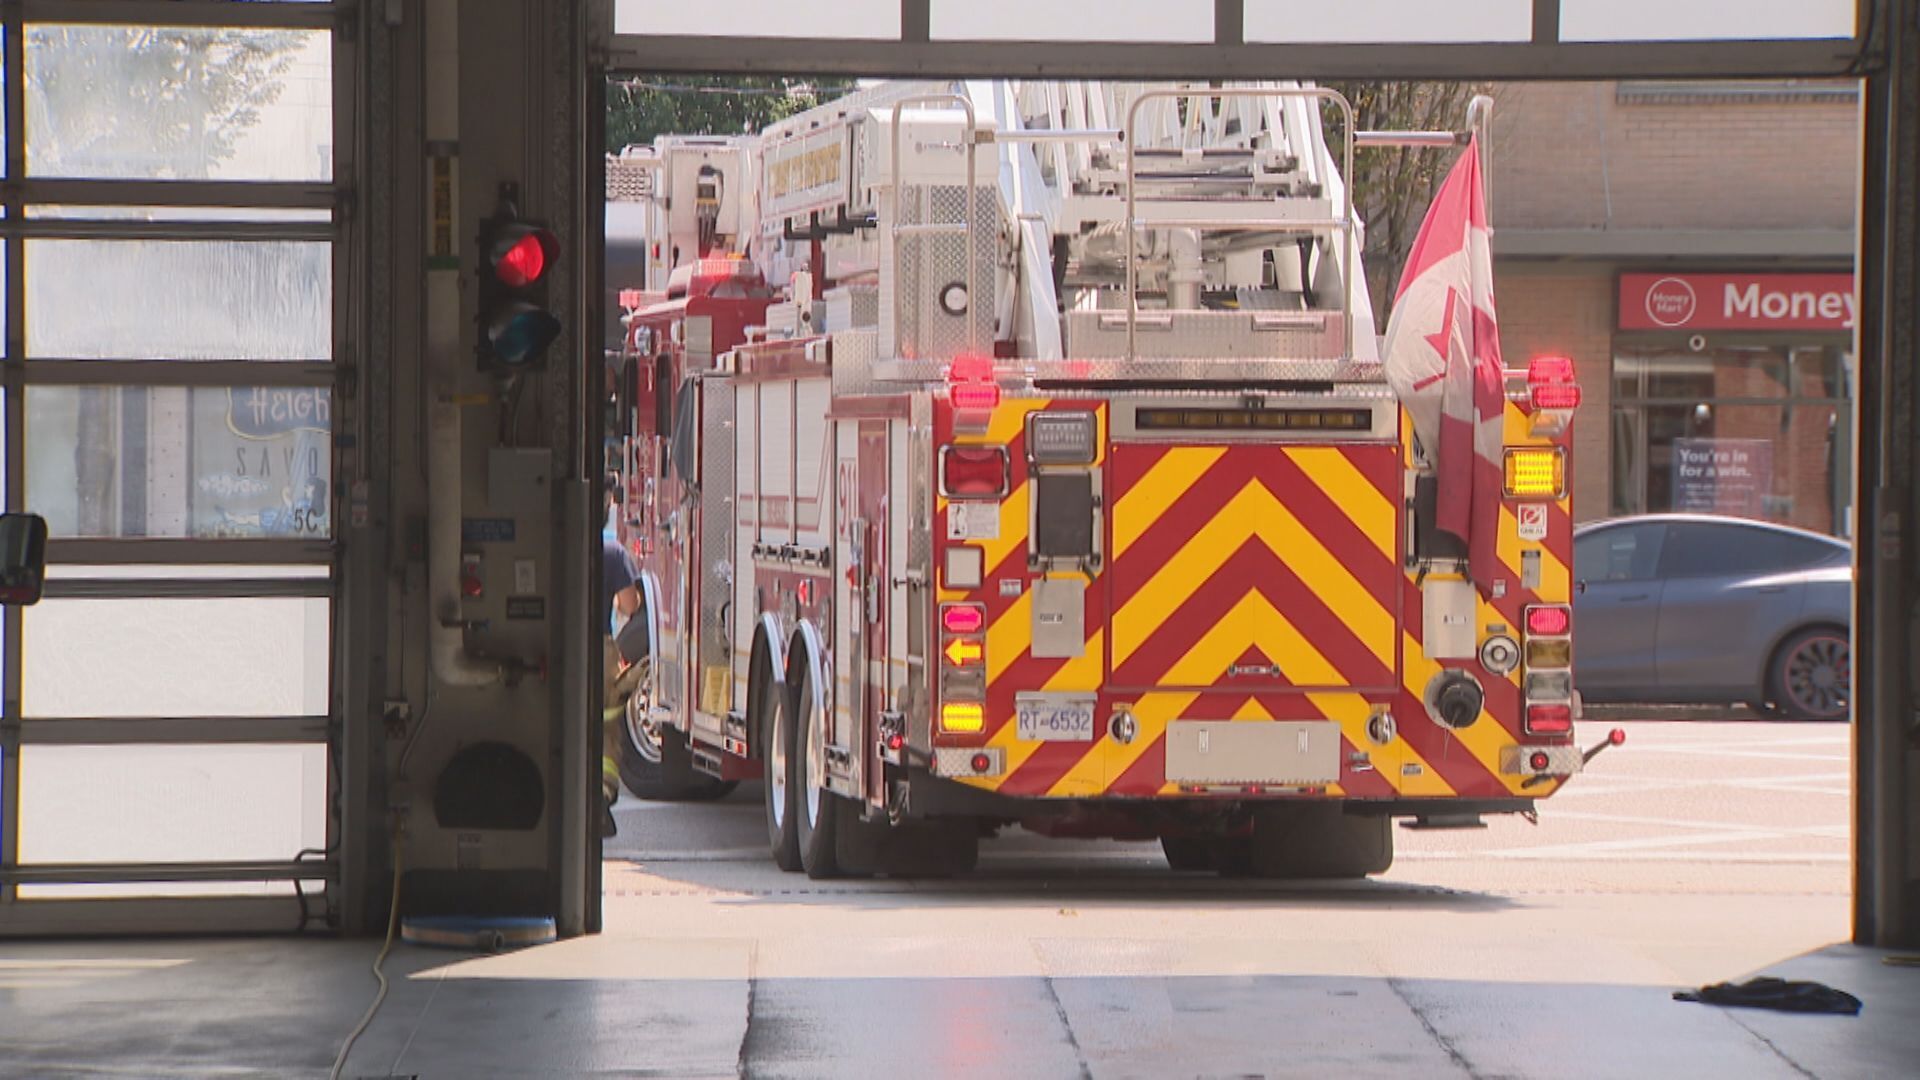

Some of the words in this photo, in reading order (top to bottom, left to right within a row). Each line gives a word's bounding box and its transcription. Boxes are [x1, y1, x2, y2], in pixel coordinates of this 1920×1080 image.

[1724, 283, 1854, 327] Money
[1680, 449, 1729, 462] You're
[1733, 449, 1748, 462] in
[1680, 465, 1703, 477] for
[1706, 466, 1715, 477] a
[1719, 465, 1752, 477] win.
[1049, 711, 1090, 731] 6532
